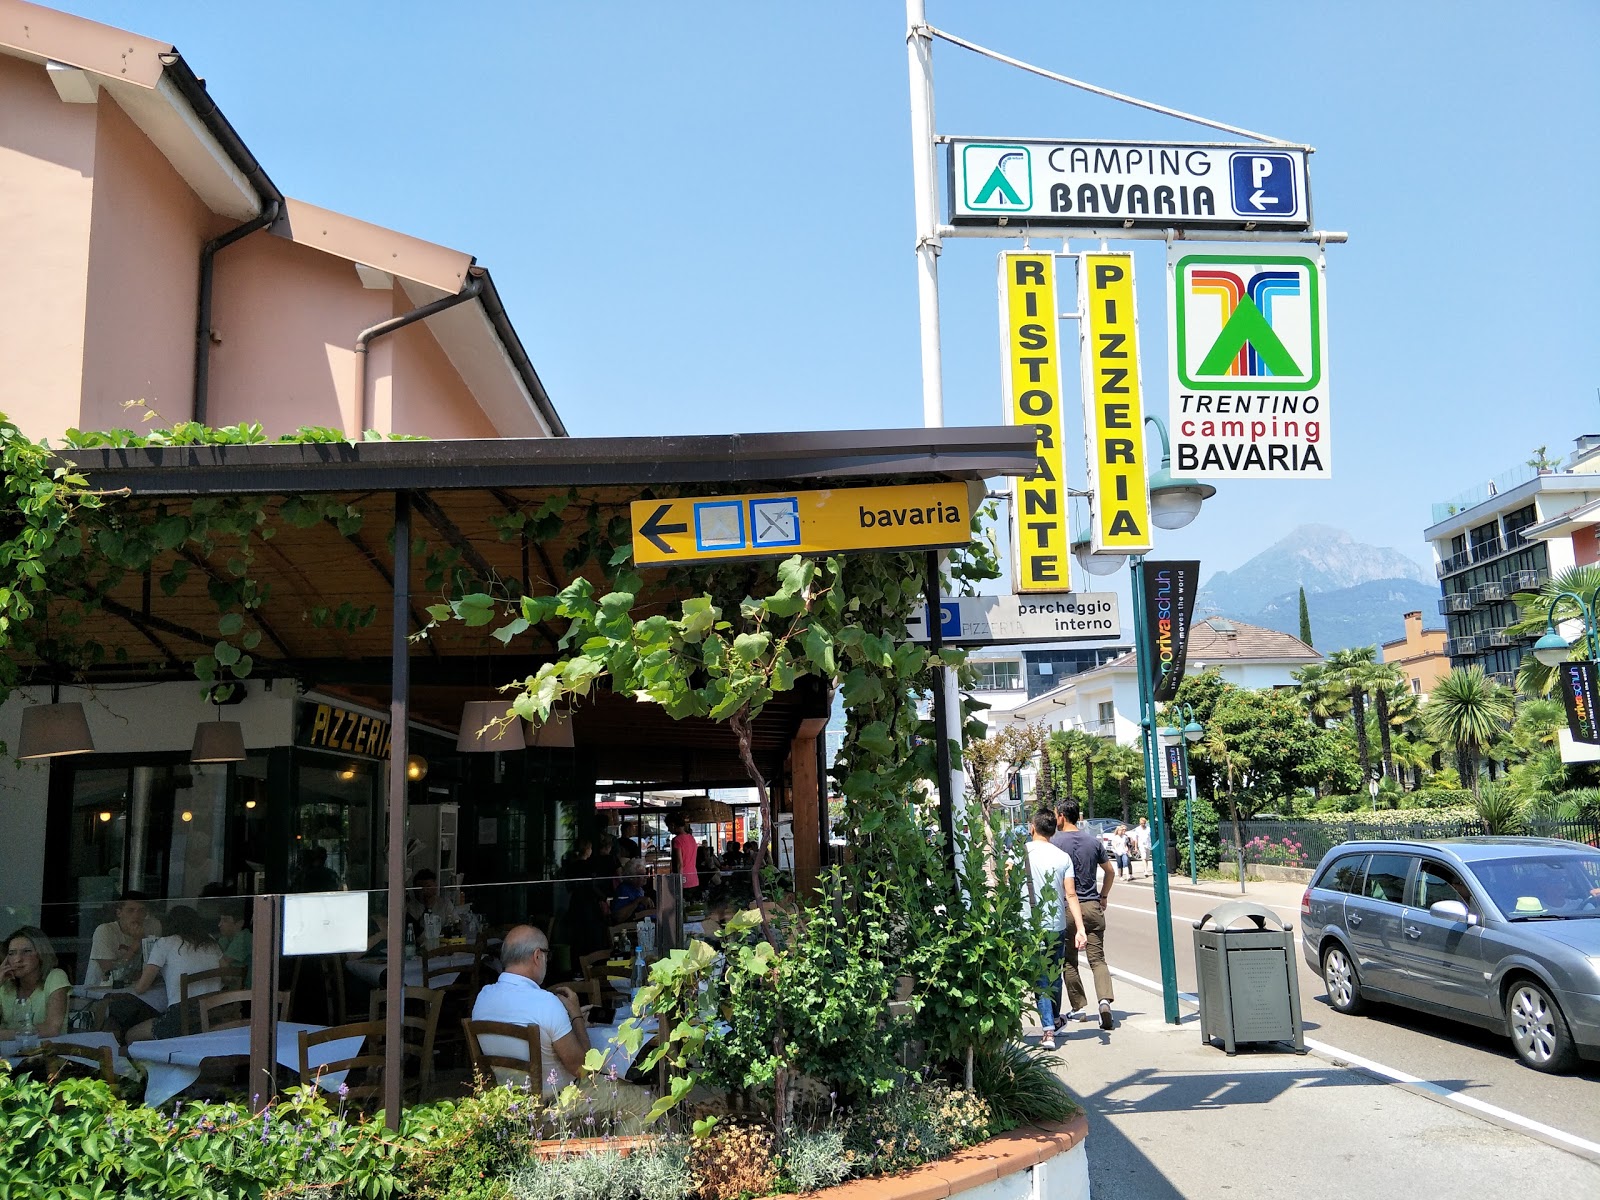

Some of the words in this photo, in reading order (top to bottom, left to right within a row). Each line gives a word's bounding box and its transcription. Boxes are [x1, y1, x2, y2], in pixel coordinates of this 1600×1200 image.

[1048, 147, 1212, 176] CAMPING
[1252, 157, 1273, 188] P
[1050, 182, 1216, 216] BAVARIA
[1094, 264, 1142, 537] PIZZERIA
[1180, 395, 1320, 415] TRENTINO
[1015, 260, 1060, 582] RISTORANTE
[1181, 415, 1321, 443] camping
[1177, 443, 1324, 471] BAVARIA
[859, 501, 961, 528] bavaria
[1018, 600, 1112, 617] parcheggio
[962, 621, 1025, 636] PIZZERIA
[1055, 618, 1112, 631] interno
[1154, 570, 1173, 690] exporivaschuh
